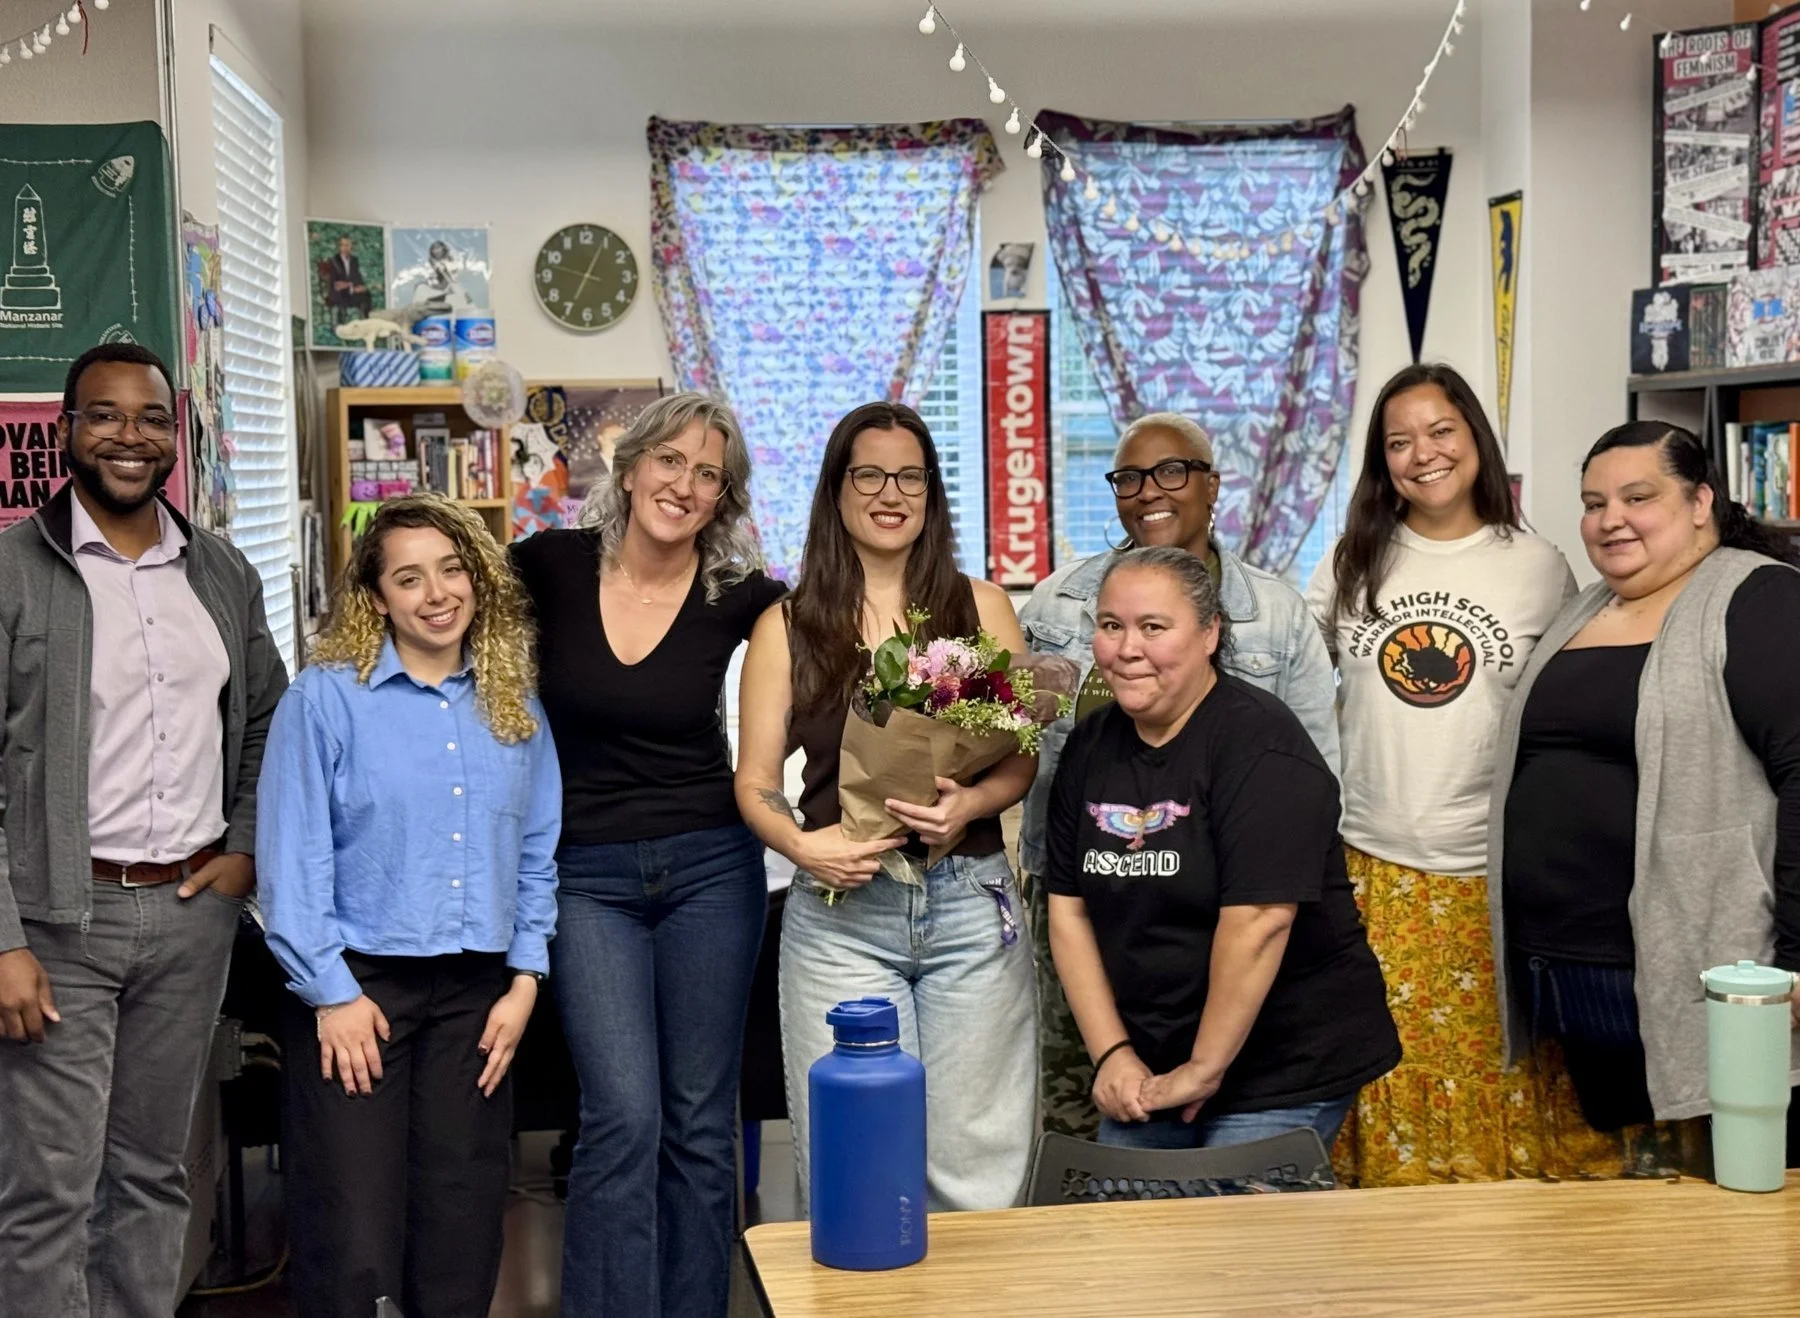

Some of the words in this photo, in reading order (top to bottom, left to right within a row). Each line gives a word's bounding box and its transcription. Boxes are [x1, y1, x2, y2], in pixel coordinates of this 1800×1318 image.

[1687, 32, 1727, 54] ROOTS
[1735, 30, 1750, 48] OF
[1676, 53, 1736, 77] FEMINISM
[579, 231, 594, 245] 12
[548, 250, 562, 264] 10
[615, 250, 625, 264] 2
[542, 268, 553, 283] 9
[622, 270, 632, 284] 3
[549, 288, 559, 303] 8
[616, 289, 625, 303] 4
[0, 310, 64, 322] Manzanar
[563, 301, 574, 316] 7
[582, 307, 593, 321] 6
[601, 302, 612, 317] 5
[1000, 315, 1045, 586] Krugertown
[1348, 605, 1389, 659] ARISE
[1389, 591, 1451, 612] HIGH
[1453, 597, 1515, 673] SCHOOL
[1361, 610, 1414, 658] WARRIOR
[1415, 607, 1496, 667] INTELLECTUAL
[1082, 847, 1181, 877] ASCEND
